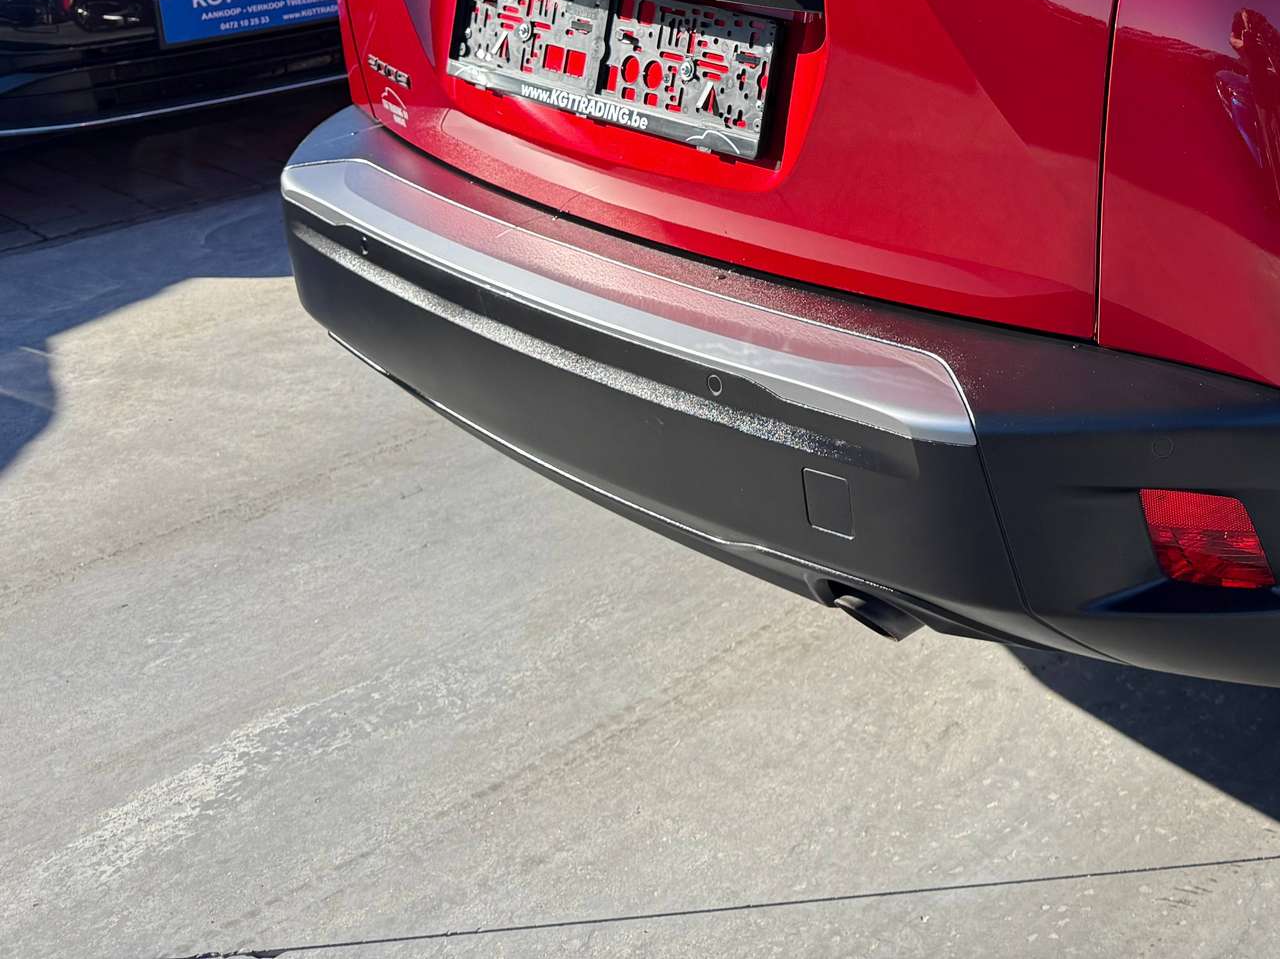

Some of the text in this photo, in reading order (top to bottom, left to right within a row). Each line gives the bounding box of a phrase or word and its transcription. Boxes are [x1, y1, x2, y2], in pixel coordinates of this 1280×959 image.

[201, 7, 242, 21] AANKOOP
[247, 0, 286, 15] VERKOOP
[367, 53, 411, 90] 2008
[521, 84, 649, 130] www.KGTTRADING.be
